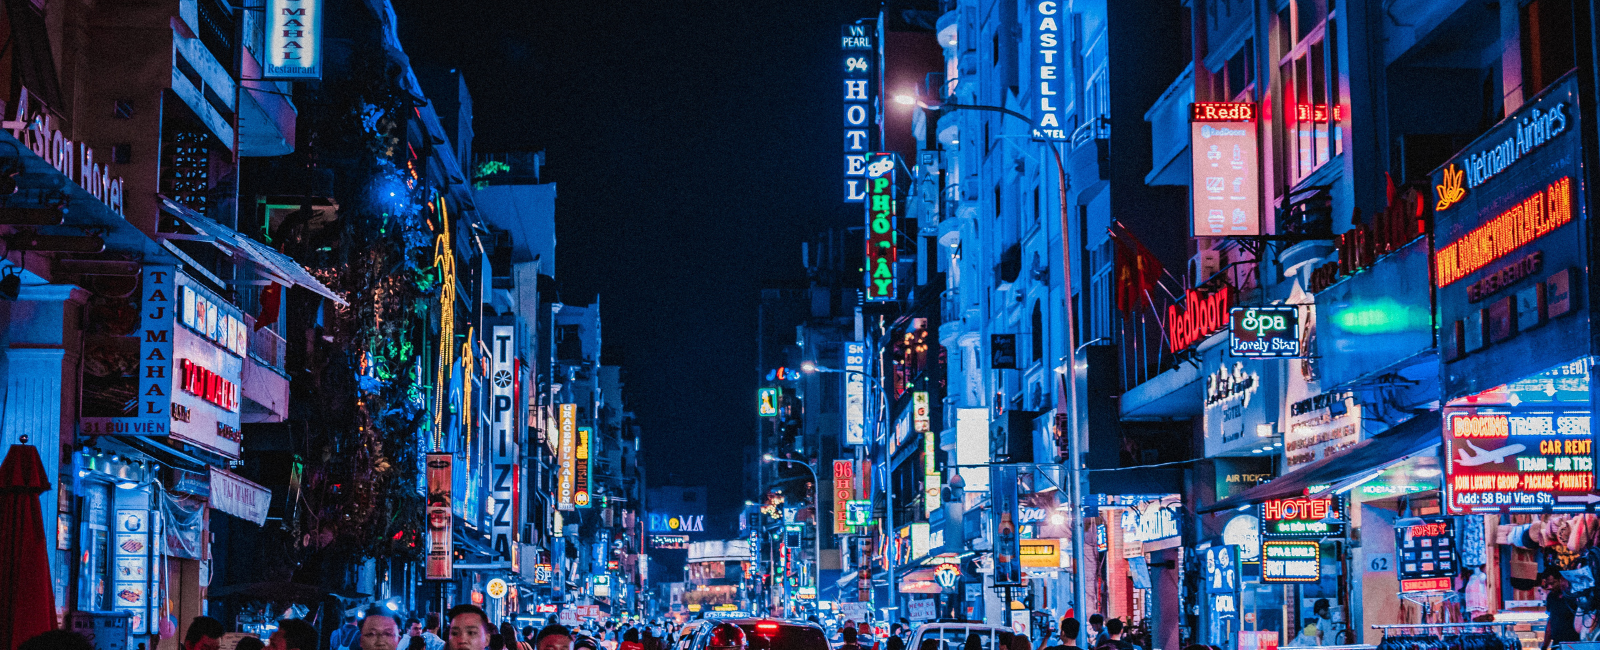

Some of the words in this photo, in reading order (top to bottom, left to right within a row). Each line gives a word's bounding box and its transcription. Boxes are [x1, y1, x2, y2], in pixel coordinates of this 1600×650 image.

[281, 8, 306, 59] MAHAL
[850, 26, 864, 36] VN
[843, 37, 871, 47] PEARL
[268, 63, 316, 74] Restaurant
[846, 57, 868, 71] 94
[1038, 1, 1058, 126] CASTELLA
[846, 80, 867, 200] HOTEL
[1033, 129, 1065, 139] HTEL
[1464, 137, 1515, 189] Vietnam
[1516, 102, 1566, 159] Airlines
[868, 157, 895, 178] 86
[81, 141, 124, 218] Hotel
[1436, 176, 1571, 289] WWW.BOOKINGYOURTRAVEL.COM
[147, 271, 169, 320] TAJ
[1169, 287, 1230, 354] RedDoorz
[1241, 309, 1287, 336] Spa
[1234, 338, 1269, 351] Lovely
[1272, 338, 1296, 350] Star
[145, 330, 168, 413] MAHAL
[84, 422, 100, 434] 31
[563, 404, 572, 460] GRACEFUL
[1454, 415, 1509, 438] BOOKING
[1509, 416, 1556, 435] TRAVEL
[1540, 440, 1561, 455] CAR
[1564, 439, 1592, 455] RENT
[834, 462, 852, 478] 96
[1517, 457, 1547, 471] TRAIN
[1553, 457, 1571, 471] AIR
[562, 461, 572, 504] SAIGON
[1226, 474, 1240, 483] AIR
[1454, 475, 1470, 490] JOIN
[1497, 475, 1519, 490] GROUP
[1524, 475, 1554, 490] PACKAGE
[837, 479, 850, 532] HOTEL
[1457, 493, 1480, 504] Add:
[1482, 493, 1493, 504] 58
[1496, 492, 1512, 504] Bui
[1514, 492, 1534, 504] Vien
[1537, 492, 1554, 505] Str,
[1371, 557, 1388, 570] 62
